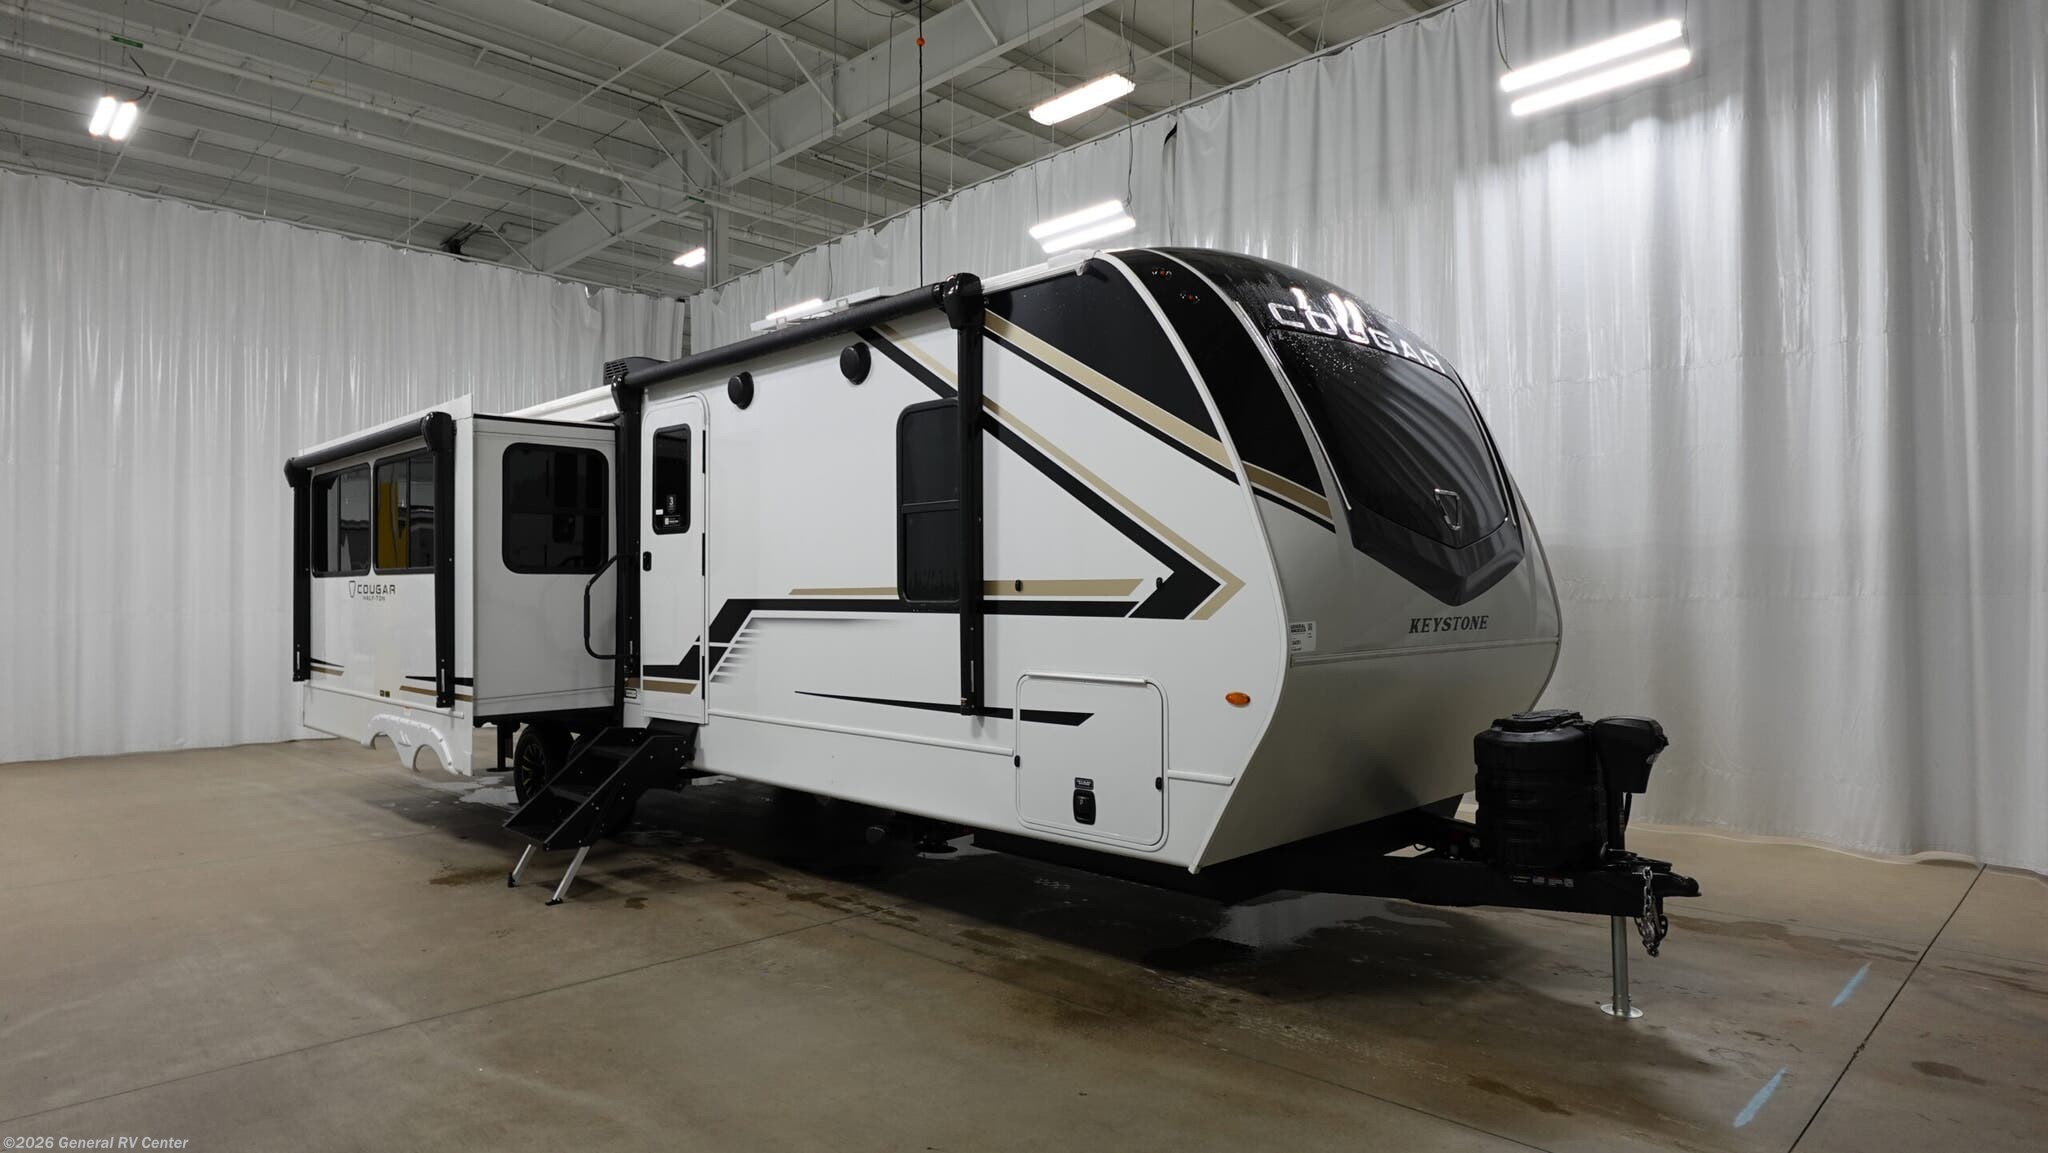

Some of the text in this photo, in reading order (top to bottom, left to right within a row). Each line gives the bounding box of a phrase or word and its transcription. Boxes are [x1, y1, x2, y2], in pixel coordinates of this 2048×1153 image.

[1268, 301, 1446, 374] COUGAR
[357, 584, 396, 594] COUGAR
[1408, 615, 1489, 634] KEYSTONE
